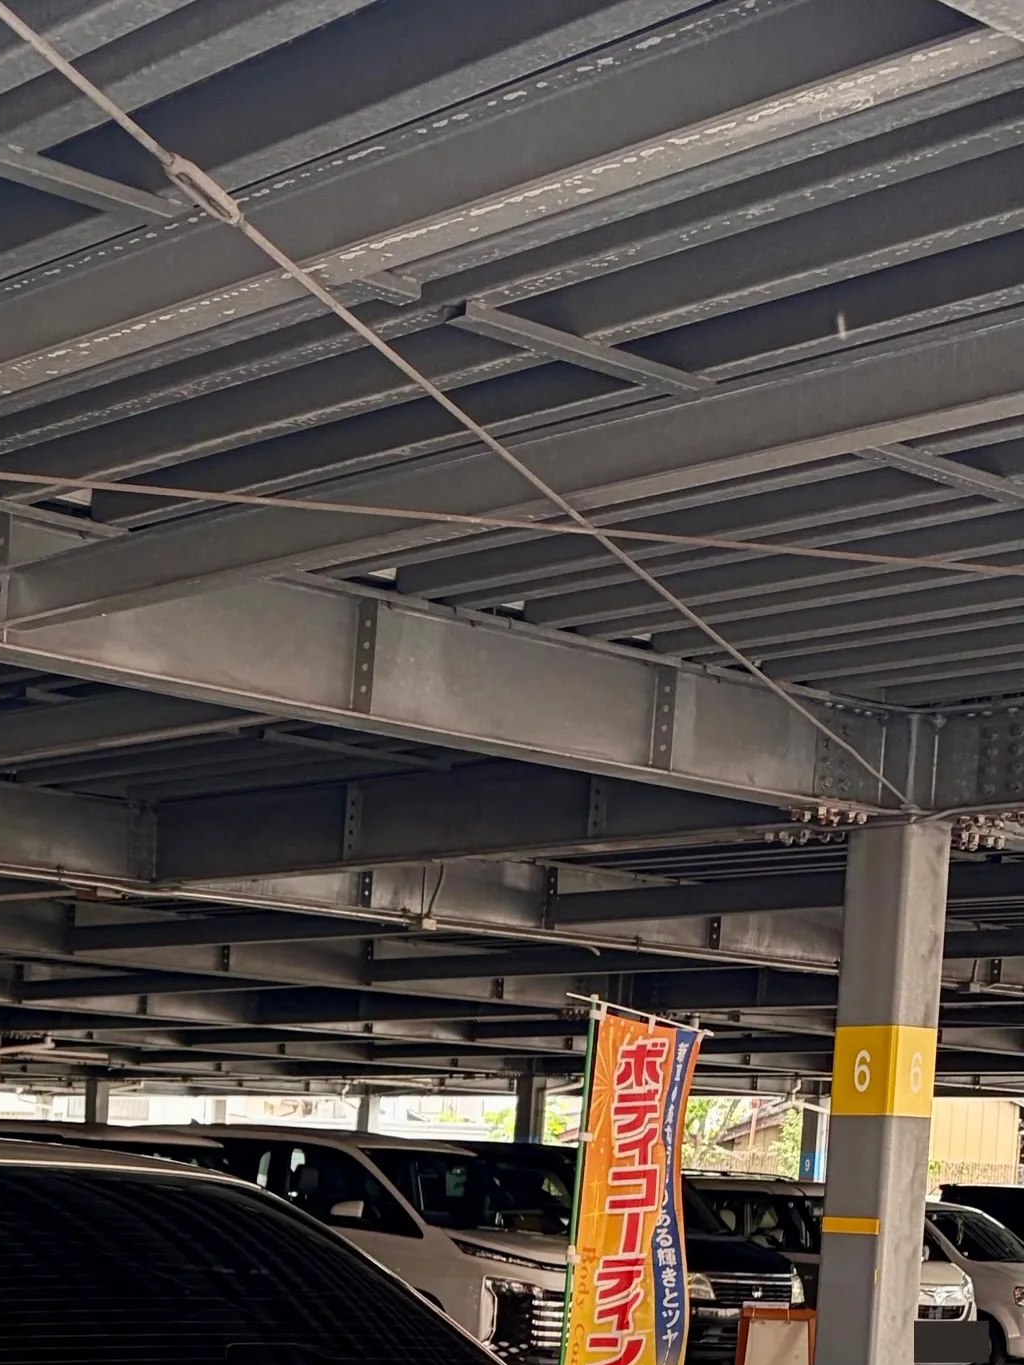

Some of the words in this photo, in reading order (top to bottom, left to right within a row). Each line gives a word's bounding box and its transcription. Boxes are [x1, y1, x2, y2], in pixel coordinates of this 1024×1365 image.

[854, 1050, 871, 1092] 6
[910, 1051, 923, 1093] 6
[804, 1159, 810, 1171] 9
[576, 1246, 596, 1308] Body
